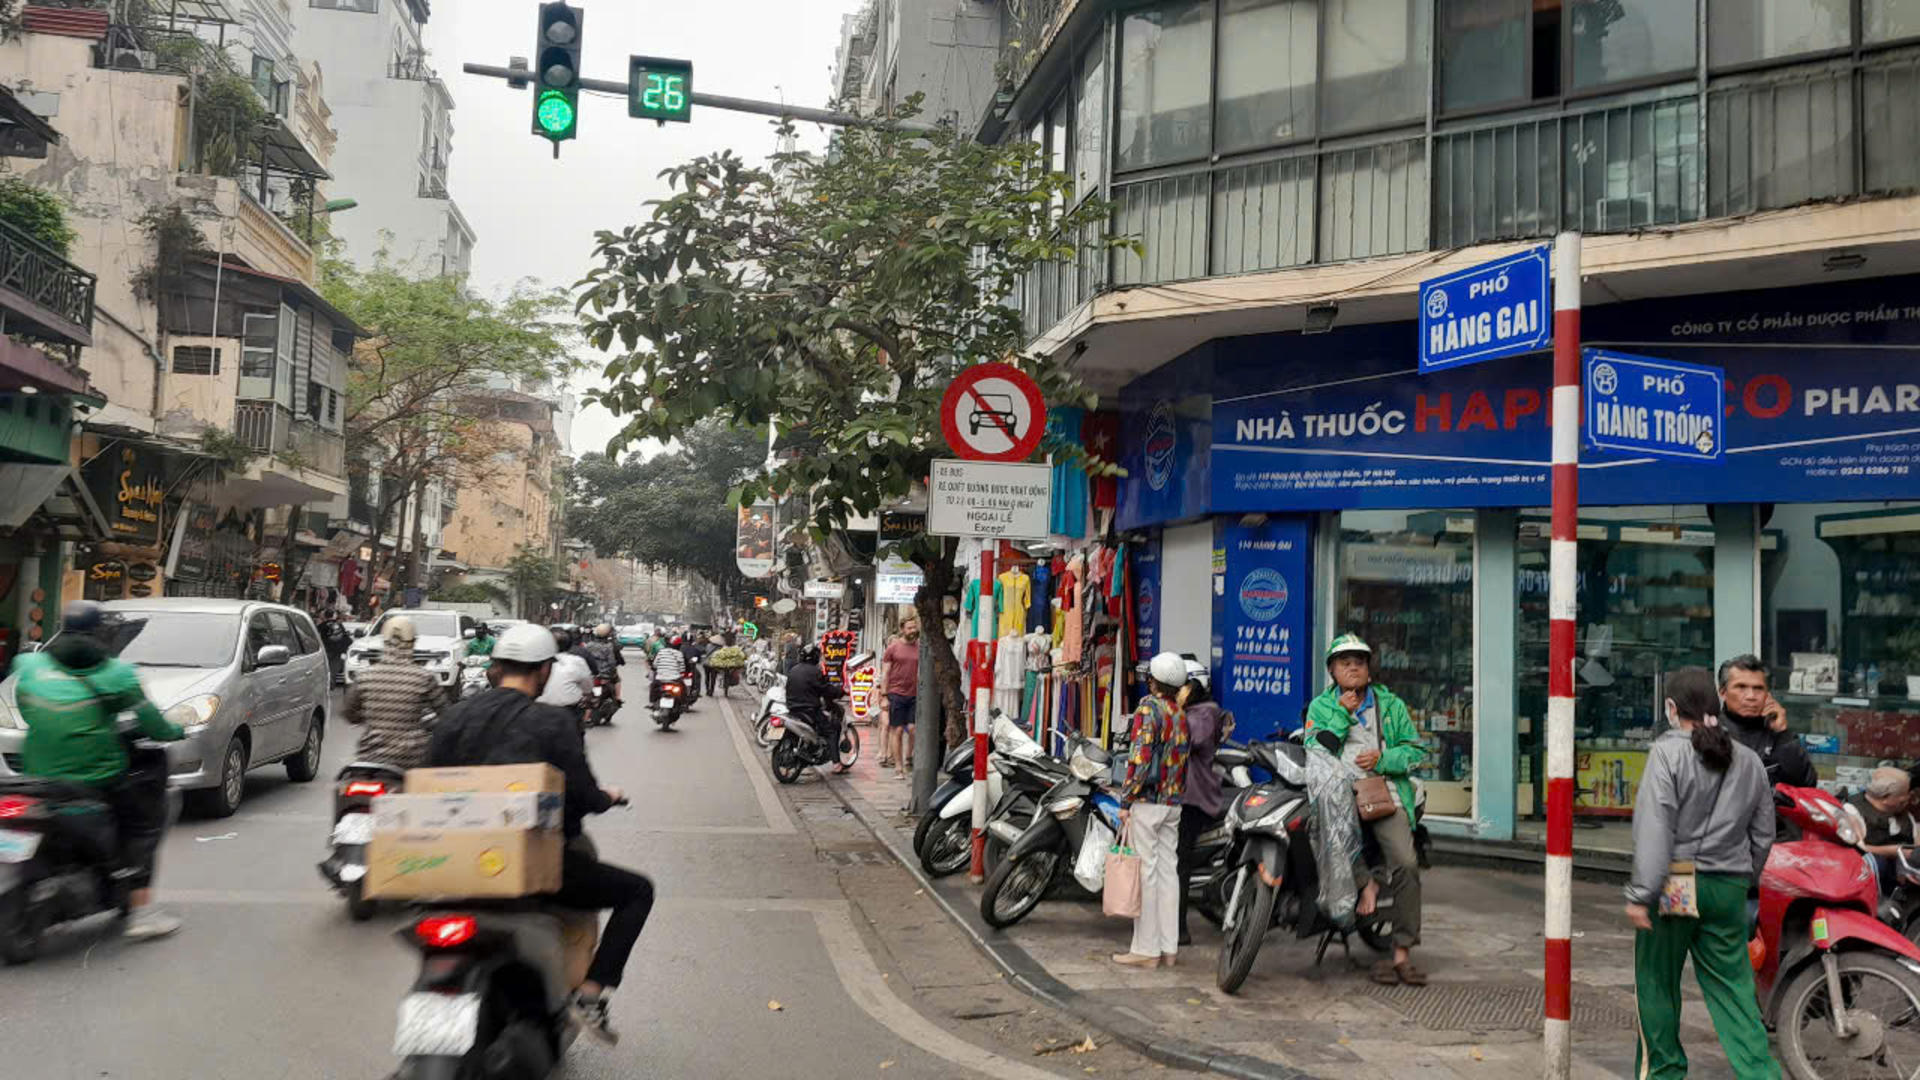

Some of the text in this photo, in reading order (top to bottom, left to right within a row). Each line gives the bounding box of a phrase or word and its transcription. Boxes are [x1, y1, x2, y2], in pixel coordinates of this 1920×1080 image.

[642, 74, 684, 111] 26
[1469, 267, 1510, 299] PHỐ
[1430, 299, 1538, 355] HÀNG GAI
[1671, 321, 1714, 336] CÔNG
[1718, 321, 1733, 333] TY
[1737, 313, 1760, 331] CỔ
[1643, 373, 1685, 396] PHỐ
[1236, 410, 1295, 442] NHÀ
[1302, 401, 1407, 438] THUỐC
[1597, 396, 1649, 440] HÀNG
[974, 523, 1006, 535] Except
[825, 644, 847, 660] Spa
[1233, 678, 1291, 695] ADVICE
